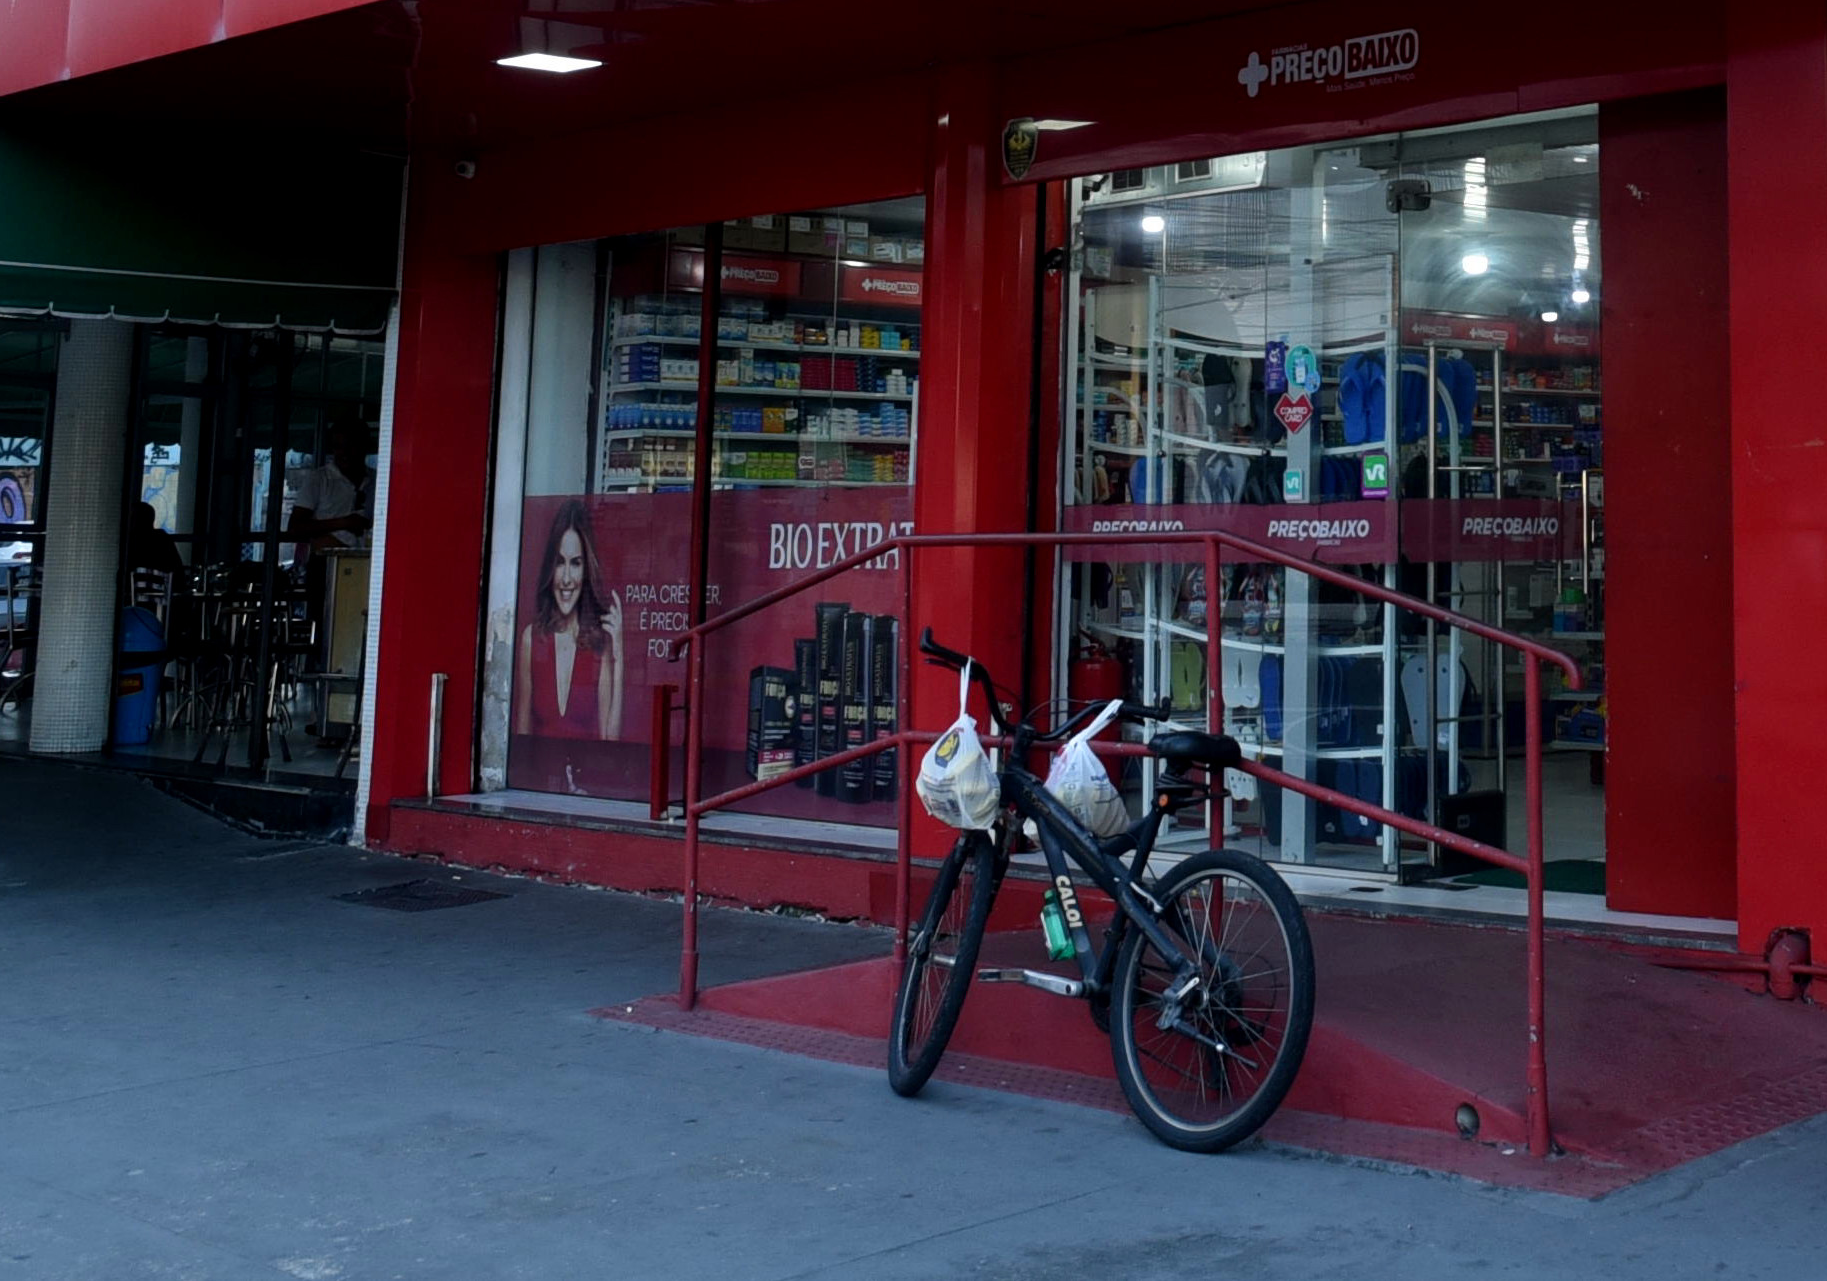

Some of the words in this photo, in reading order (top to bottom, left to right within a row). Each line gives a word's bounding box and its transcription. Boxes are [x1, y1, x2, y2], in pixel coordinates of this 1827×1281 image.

[625, 584, 657, 603] PARA
[660, 584, 722, 606] CREER,
[640, 607, 648, 631] É
[650, 611, 690, 631] PRECI
[1055, 875, 1083, 928] CALOI
